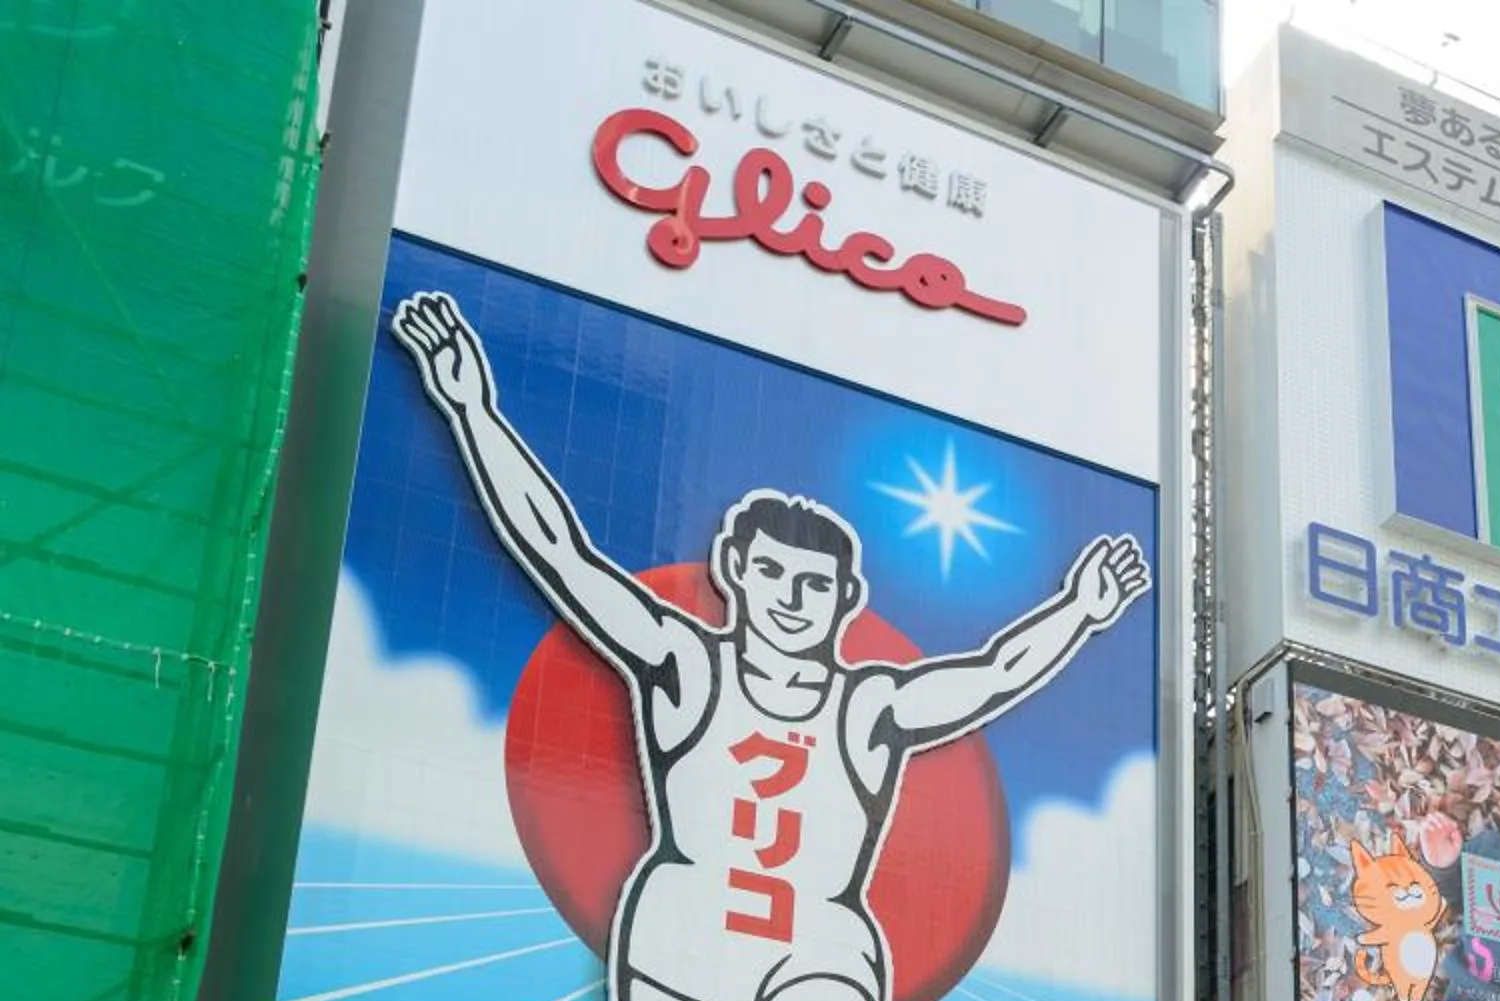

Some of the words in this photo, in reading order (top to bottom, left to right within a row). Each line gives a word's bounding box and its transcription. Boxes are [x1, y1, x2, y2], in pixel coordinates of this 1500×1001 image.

[643, 56, 989, 218] おいしさと健康
[726, 731, 816, 943] グリコ
